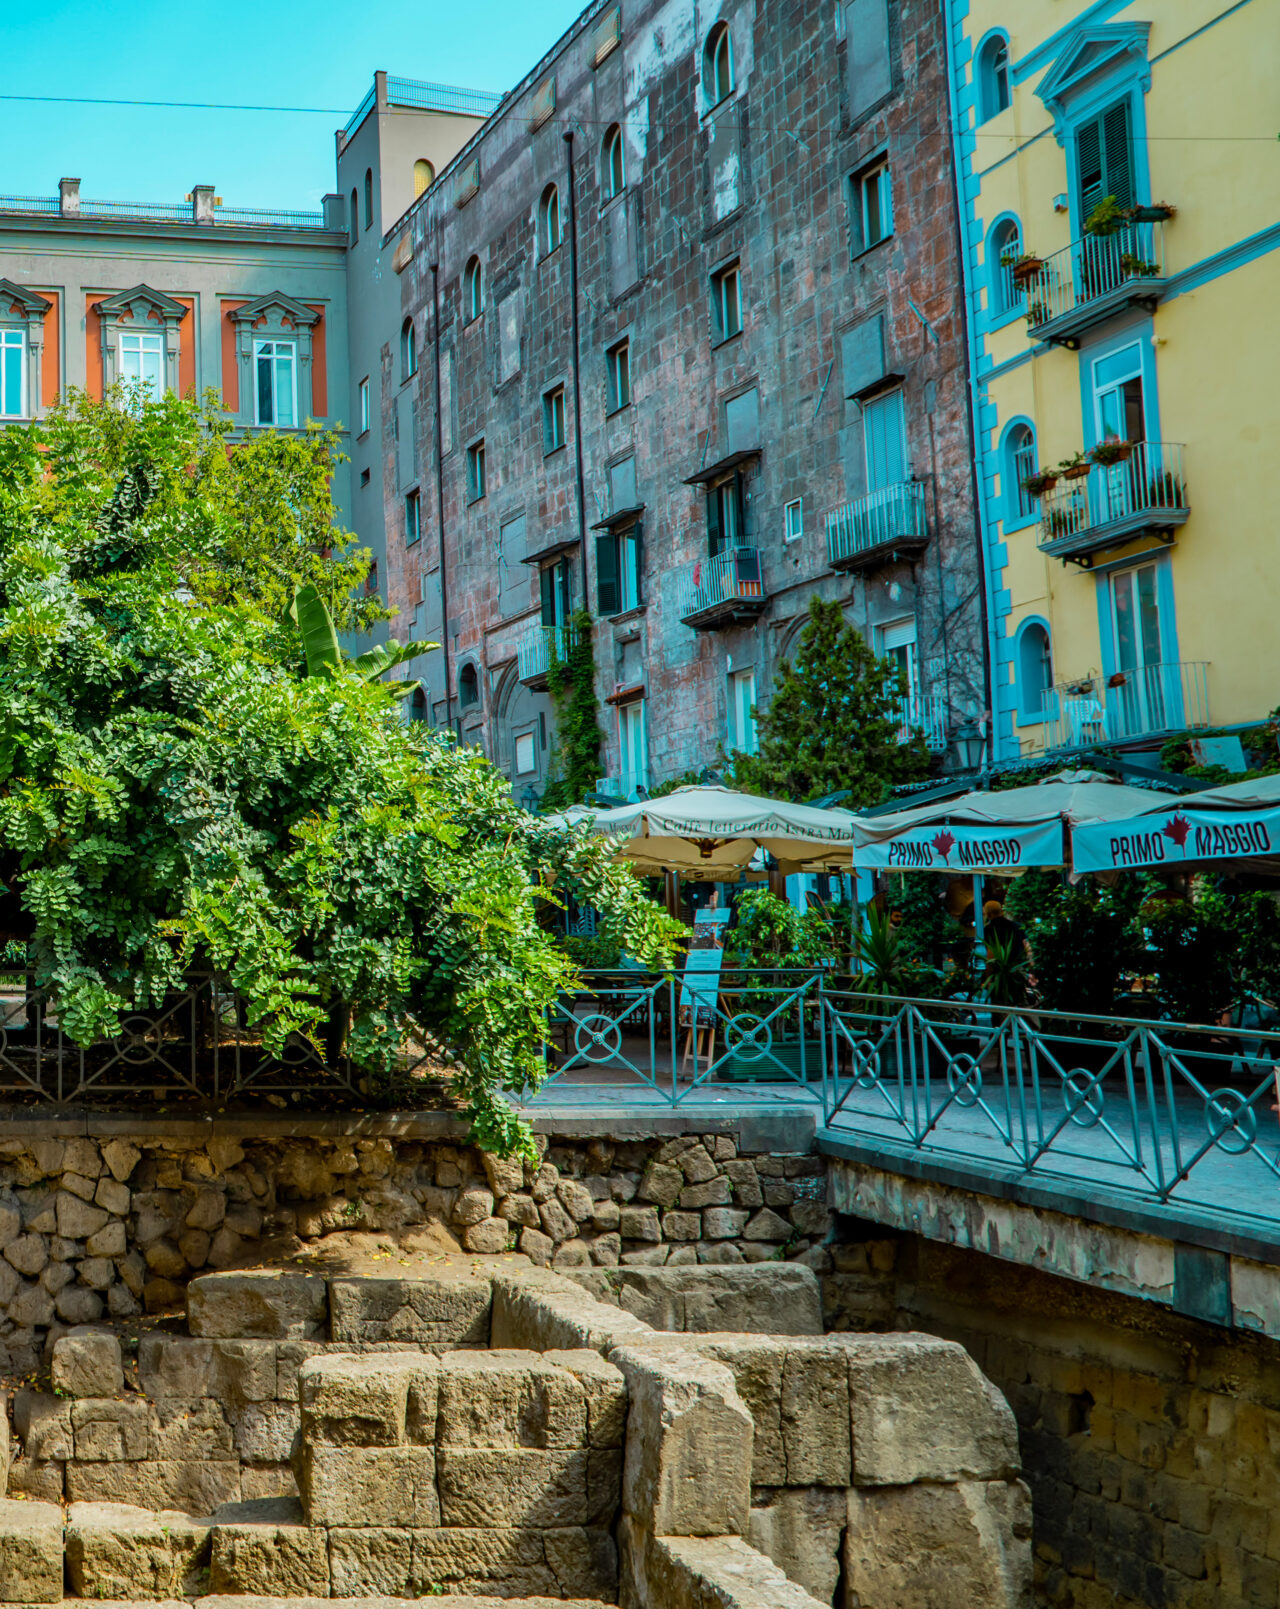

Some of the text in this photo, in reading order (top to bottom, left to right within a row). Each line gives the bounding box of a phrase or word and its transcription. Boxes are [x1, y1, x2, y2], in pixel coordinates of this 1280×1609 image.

[709, 819, 779, 834] letterario
[888, 838, 1021, 866] PRIMO MAGGIO
[1110, 821, 1271, 866] PRIMO MAGGIO
